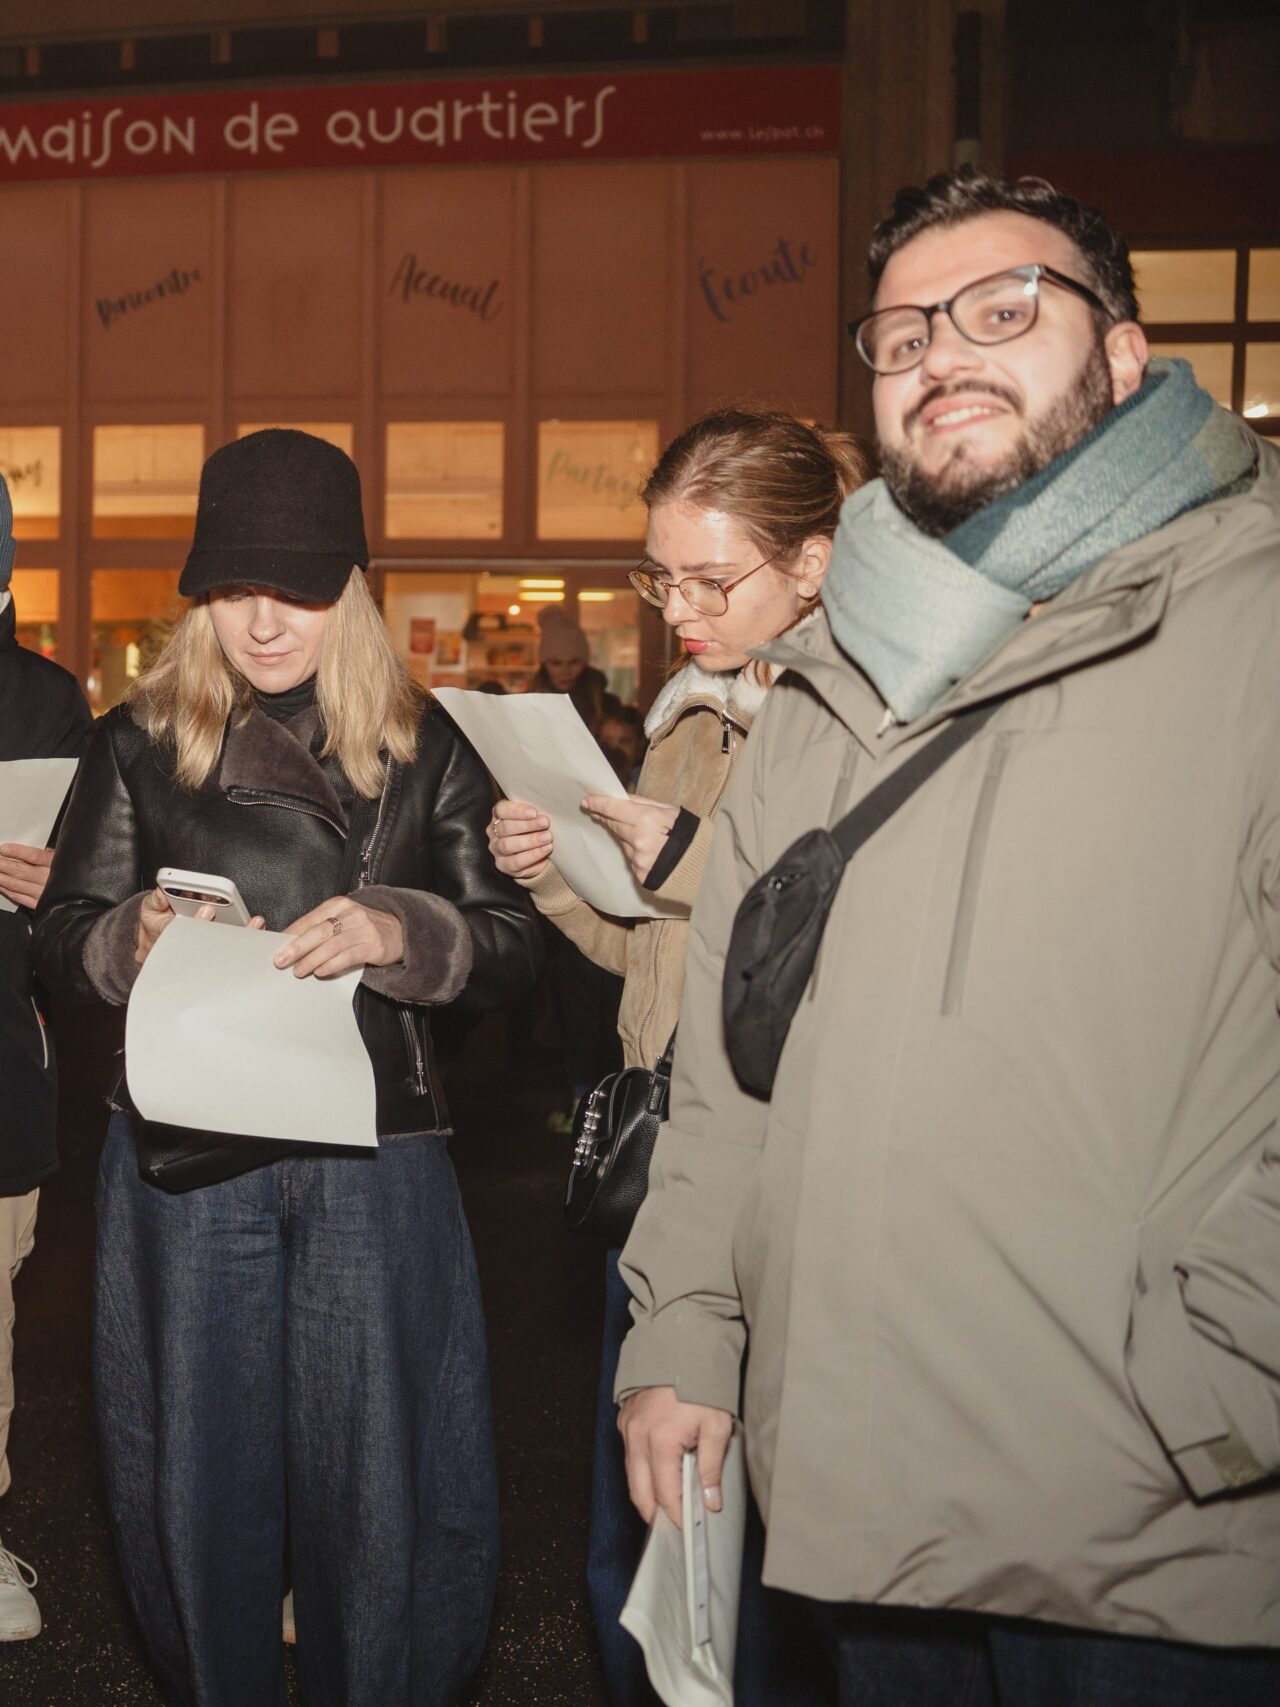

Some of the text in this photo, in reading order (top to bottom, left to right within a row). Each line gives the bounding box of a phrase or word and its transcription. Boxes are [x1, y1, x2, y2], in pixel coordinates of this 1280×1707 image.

[223, 102, 299, 154] de
[326, 86, 617, 150] quartiers
[386, 252, 505, 321] Accueil
